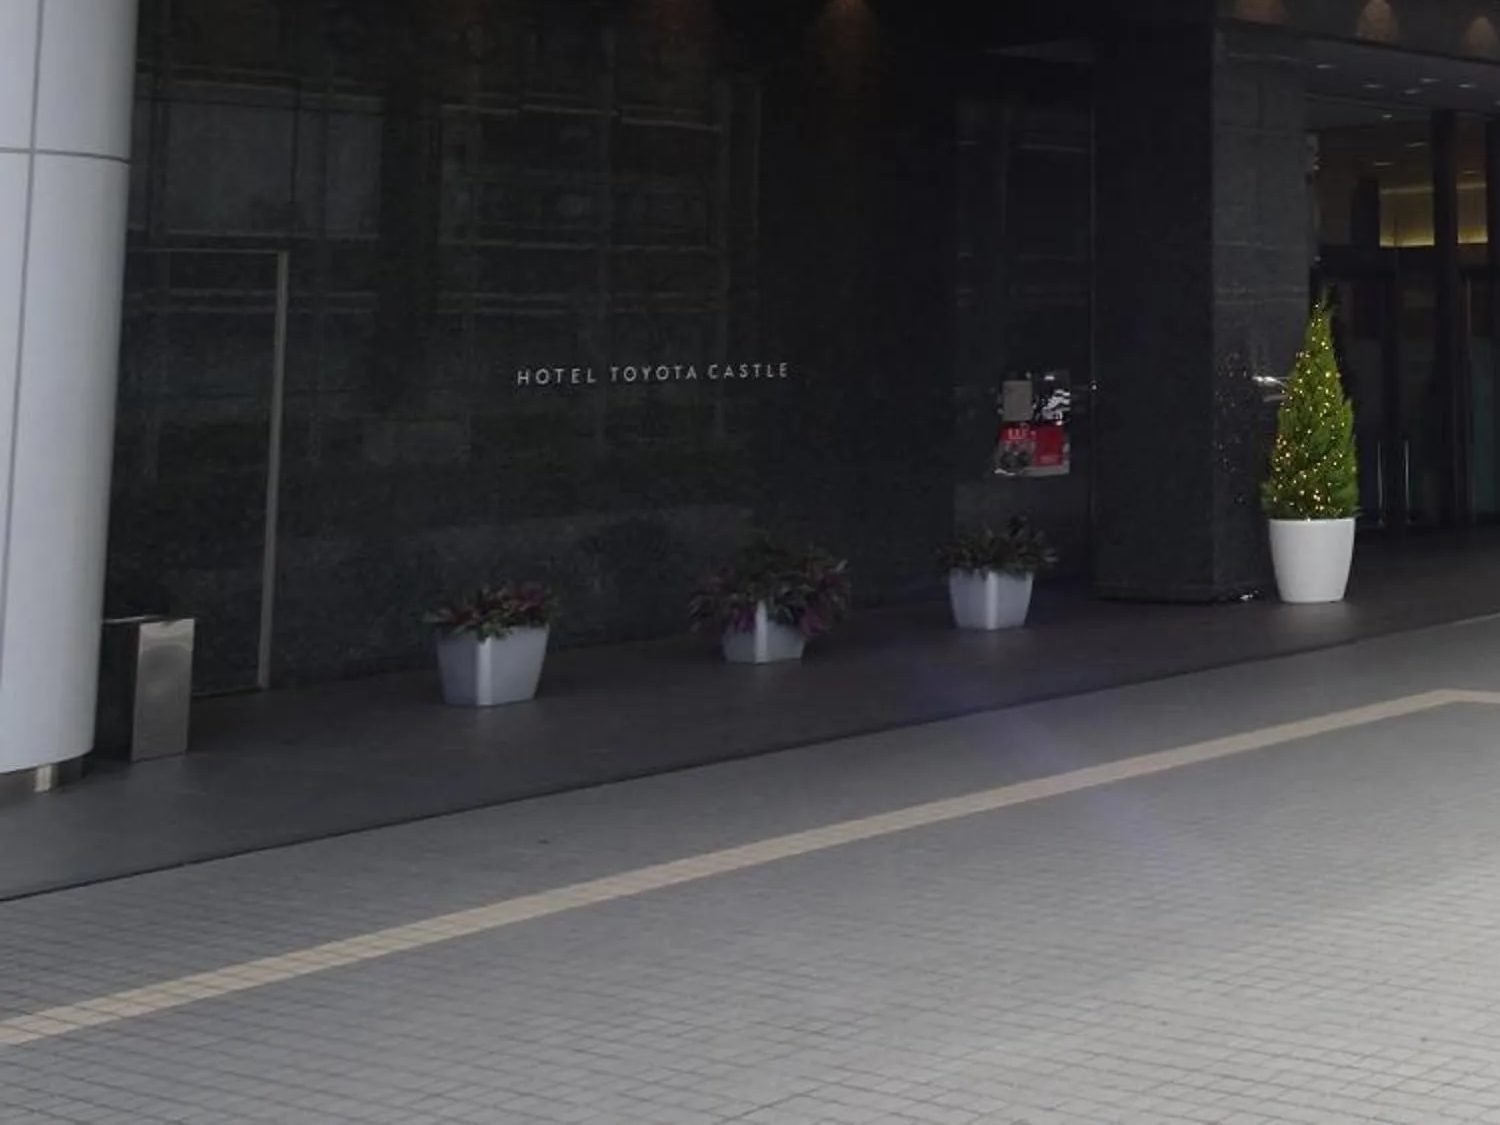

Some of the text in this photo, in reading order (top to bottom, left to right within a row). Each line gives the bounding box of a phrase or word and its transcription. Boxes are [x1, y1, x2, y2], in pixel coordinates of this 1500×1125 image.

[517, 362, 789, 386] HOTEL TOYOTA CASTLE
